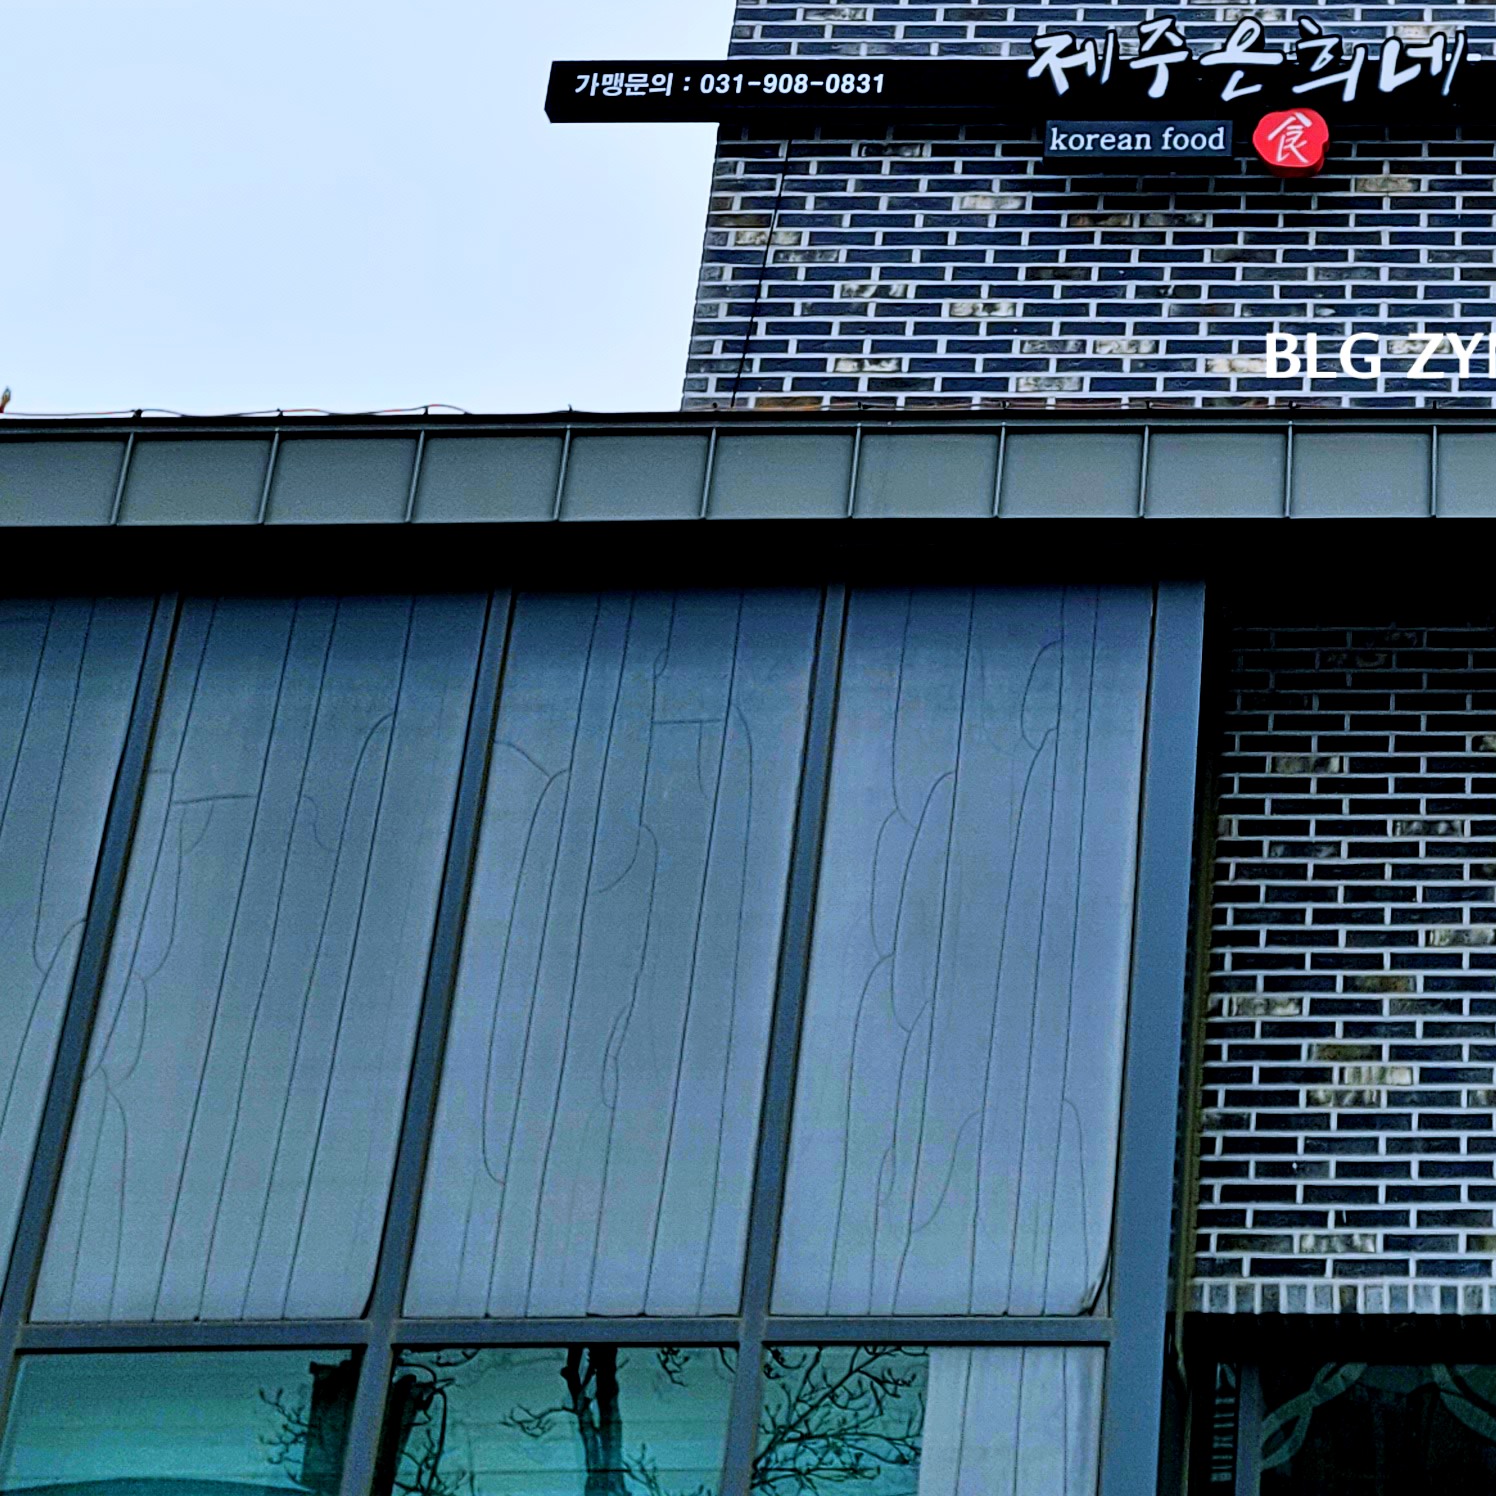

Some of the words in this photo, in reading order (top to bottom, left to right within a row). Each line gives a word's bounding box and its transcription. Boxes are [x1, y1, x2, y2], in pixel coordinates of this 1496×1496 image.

[1027, 15, 1467, 102] 제주은희네
[574, 72, 674, 97] 가맹문의
[699, 73, 885, 94] 031-908-0831
[1049, 127, 1153, 152] korean
[1160, 126, 1226, 152] food
[1267, 111, 1313, 165] 食
